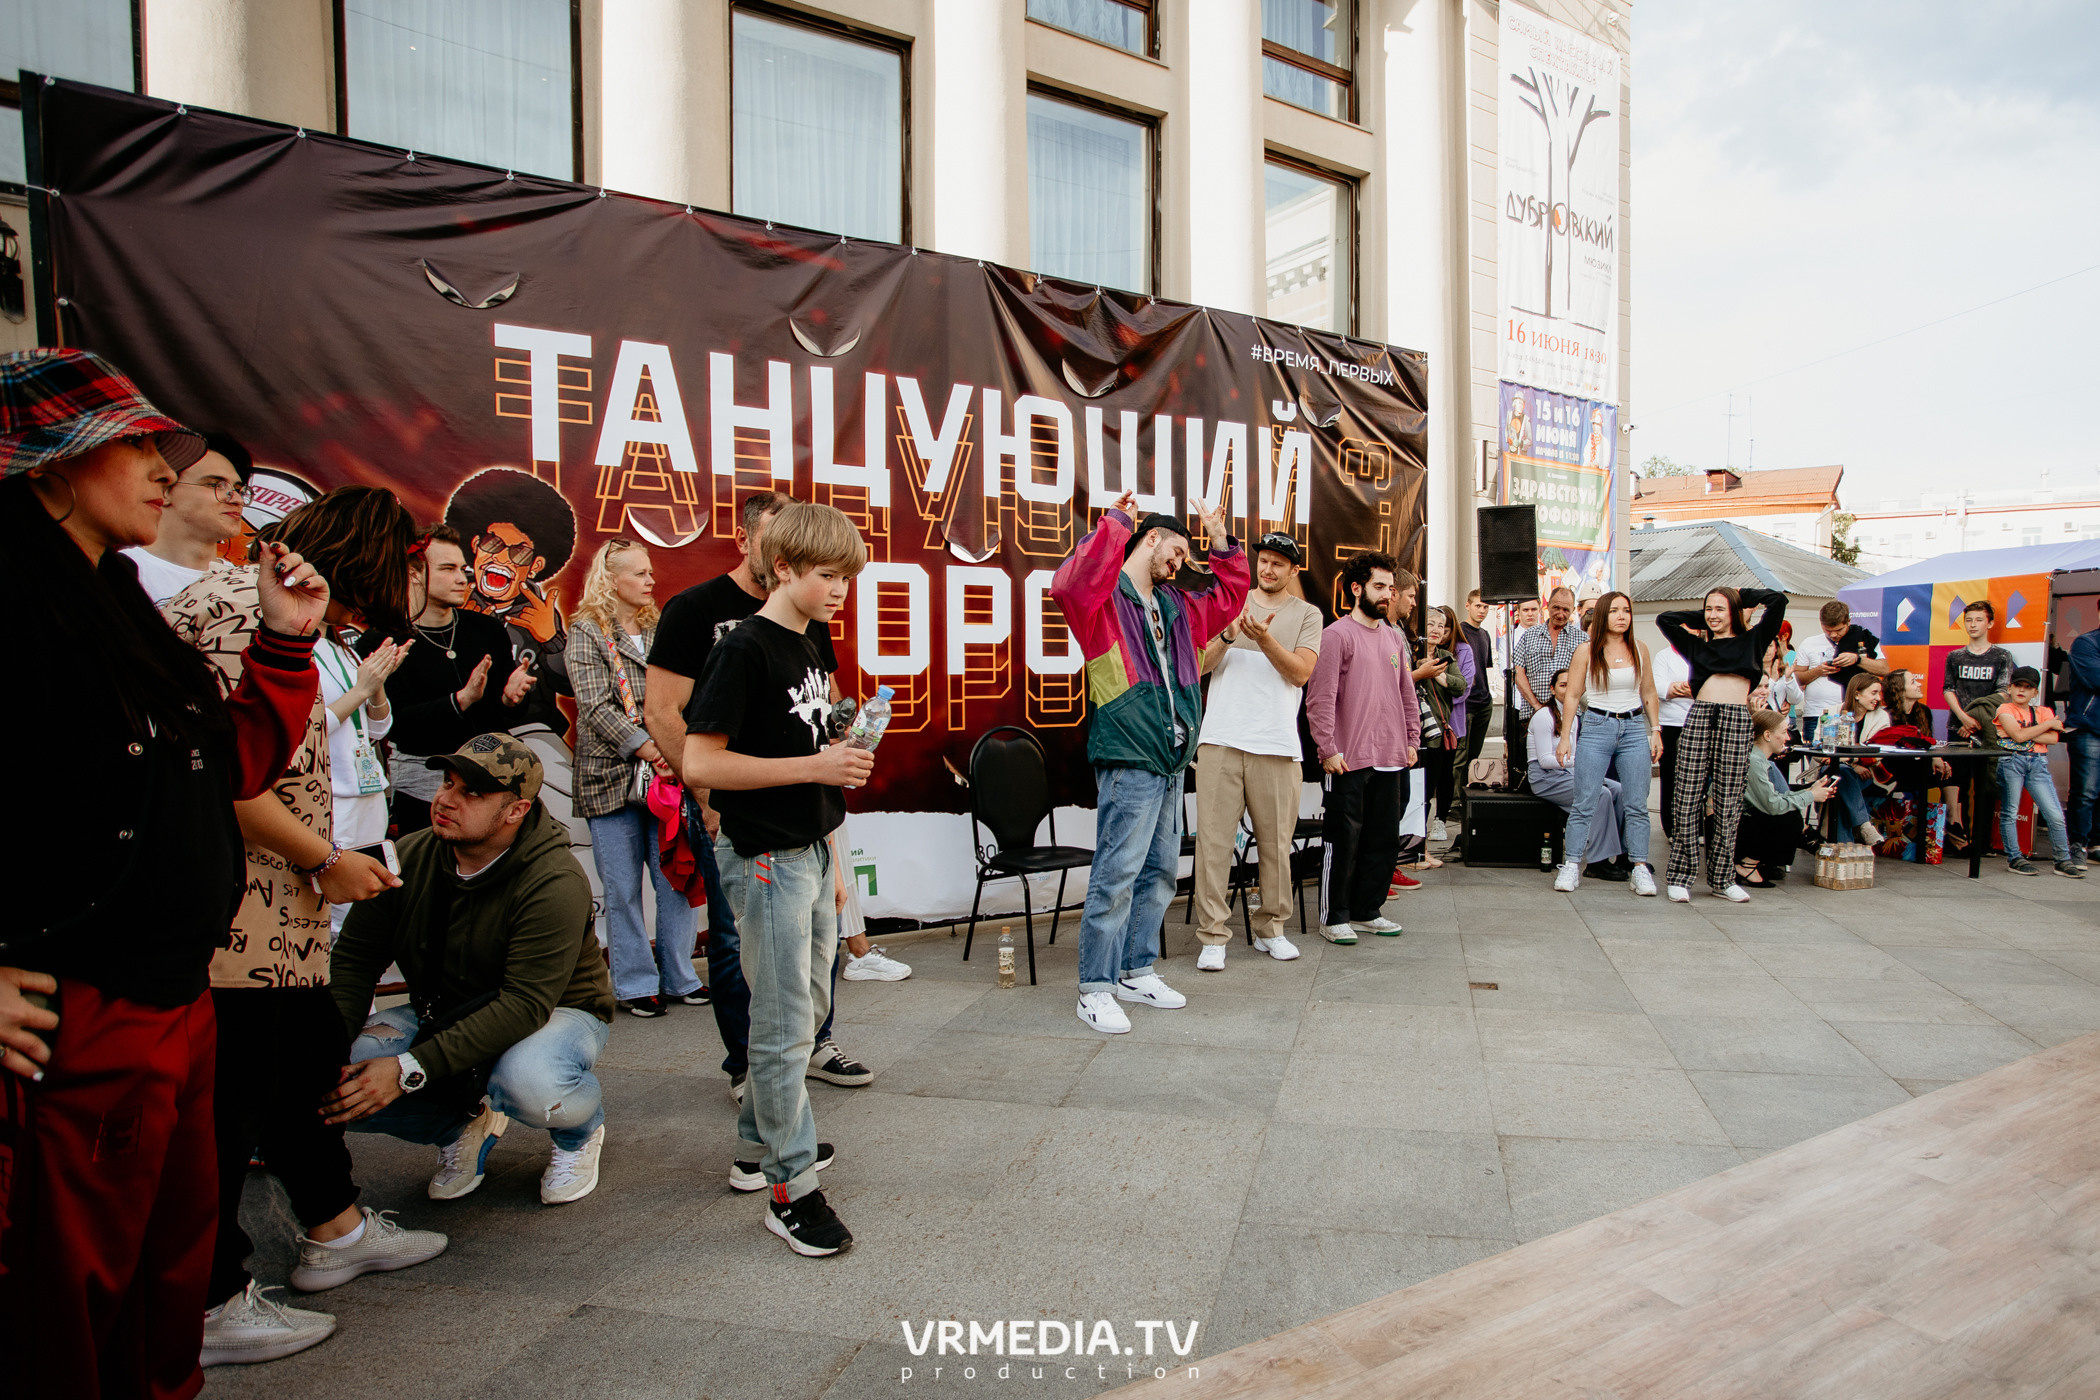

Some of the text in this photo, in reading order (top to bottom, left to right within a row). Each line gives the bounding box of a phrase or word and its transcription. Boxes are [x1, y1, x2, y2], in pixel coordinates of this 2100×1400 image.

[1508, 16, 1614, 76] САМЫЙ МАССОВЫЙ
[1506, 190, 1613, 252] ДУБРОВСКИЙ
[1584, 255, 1612, 275] МЮЗИКЛ
[1507, 319, 1526, 344] 16
[1532, 331, 1580, 357] ИЮНЯ
[1251, 344, 1394, 387] #ВРЕМЯ_ПЕРВЫХ
[494, 323, 1311, 524] ТАНЦУЮЩИЙ
[1536, 399, 1552, 421] 15
[1566, 405, 1581, 427] 16
[1535, 424, 1577, 448] ИЮНЯ
[1958, 665, 1993, 680] LEADER
